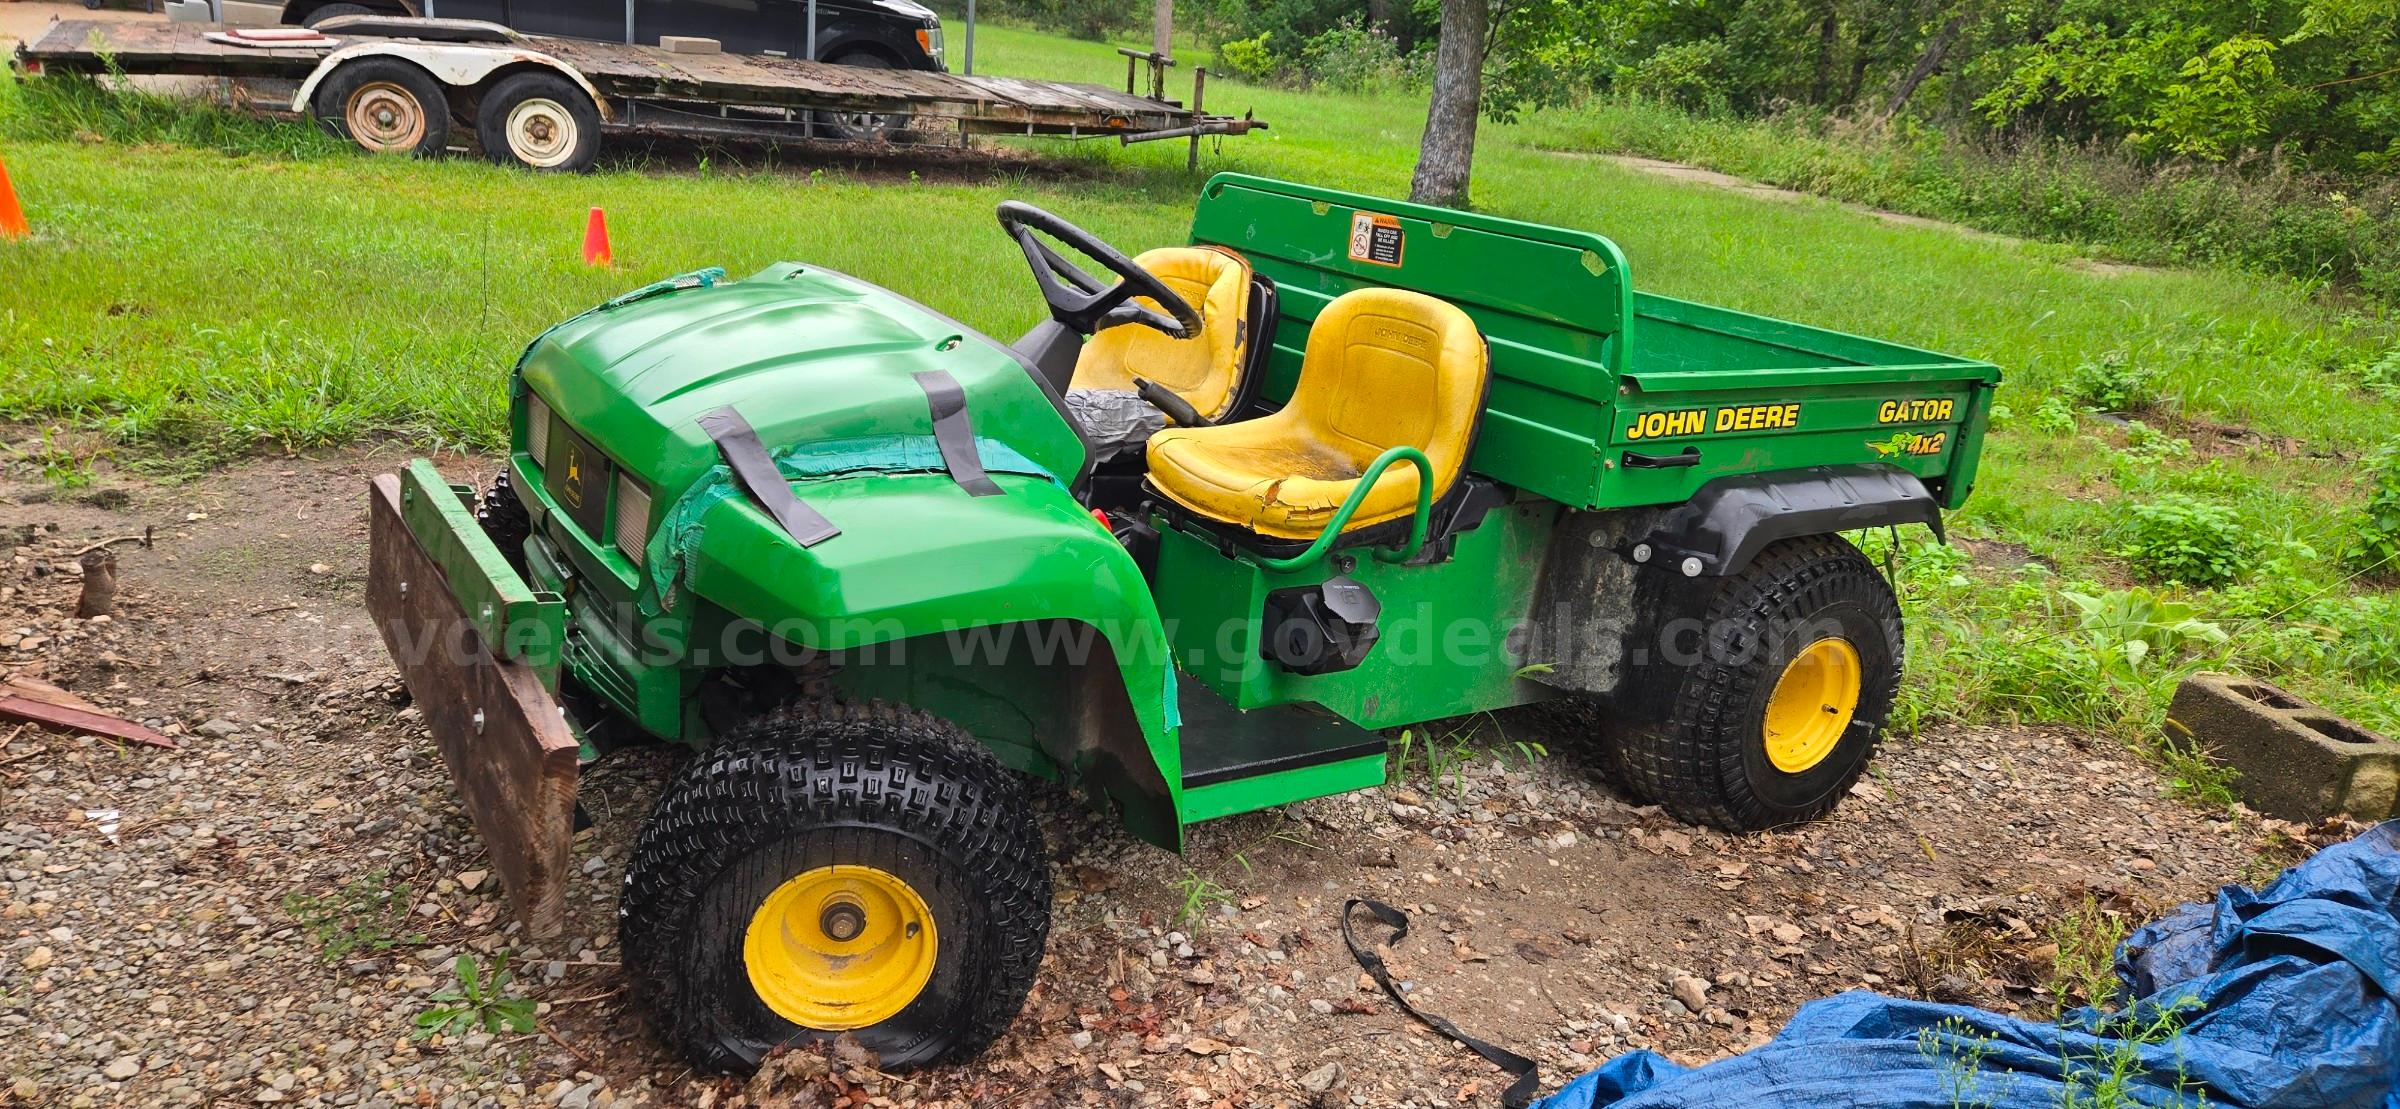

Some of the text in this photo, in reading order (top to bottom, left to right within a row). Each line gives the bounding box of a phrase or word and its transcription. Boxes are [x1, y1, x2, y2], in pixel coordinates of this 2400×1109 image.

[1626, 403, 1801, 440] JOHN DEERE
[1878, 398, 1954, 424] GATOR
[1906, 432, 1947, 455] 4x2
